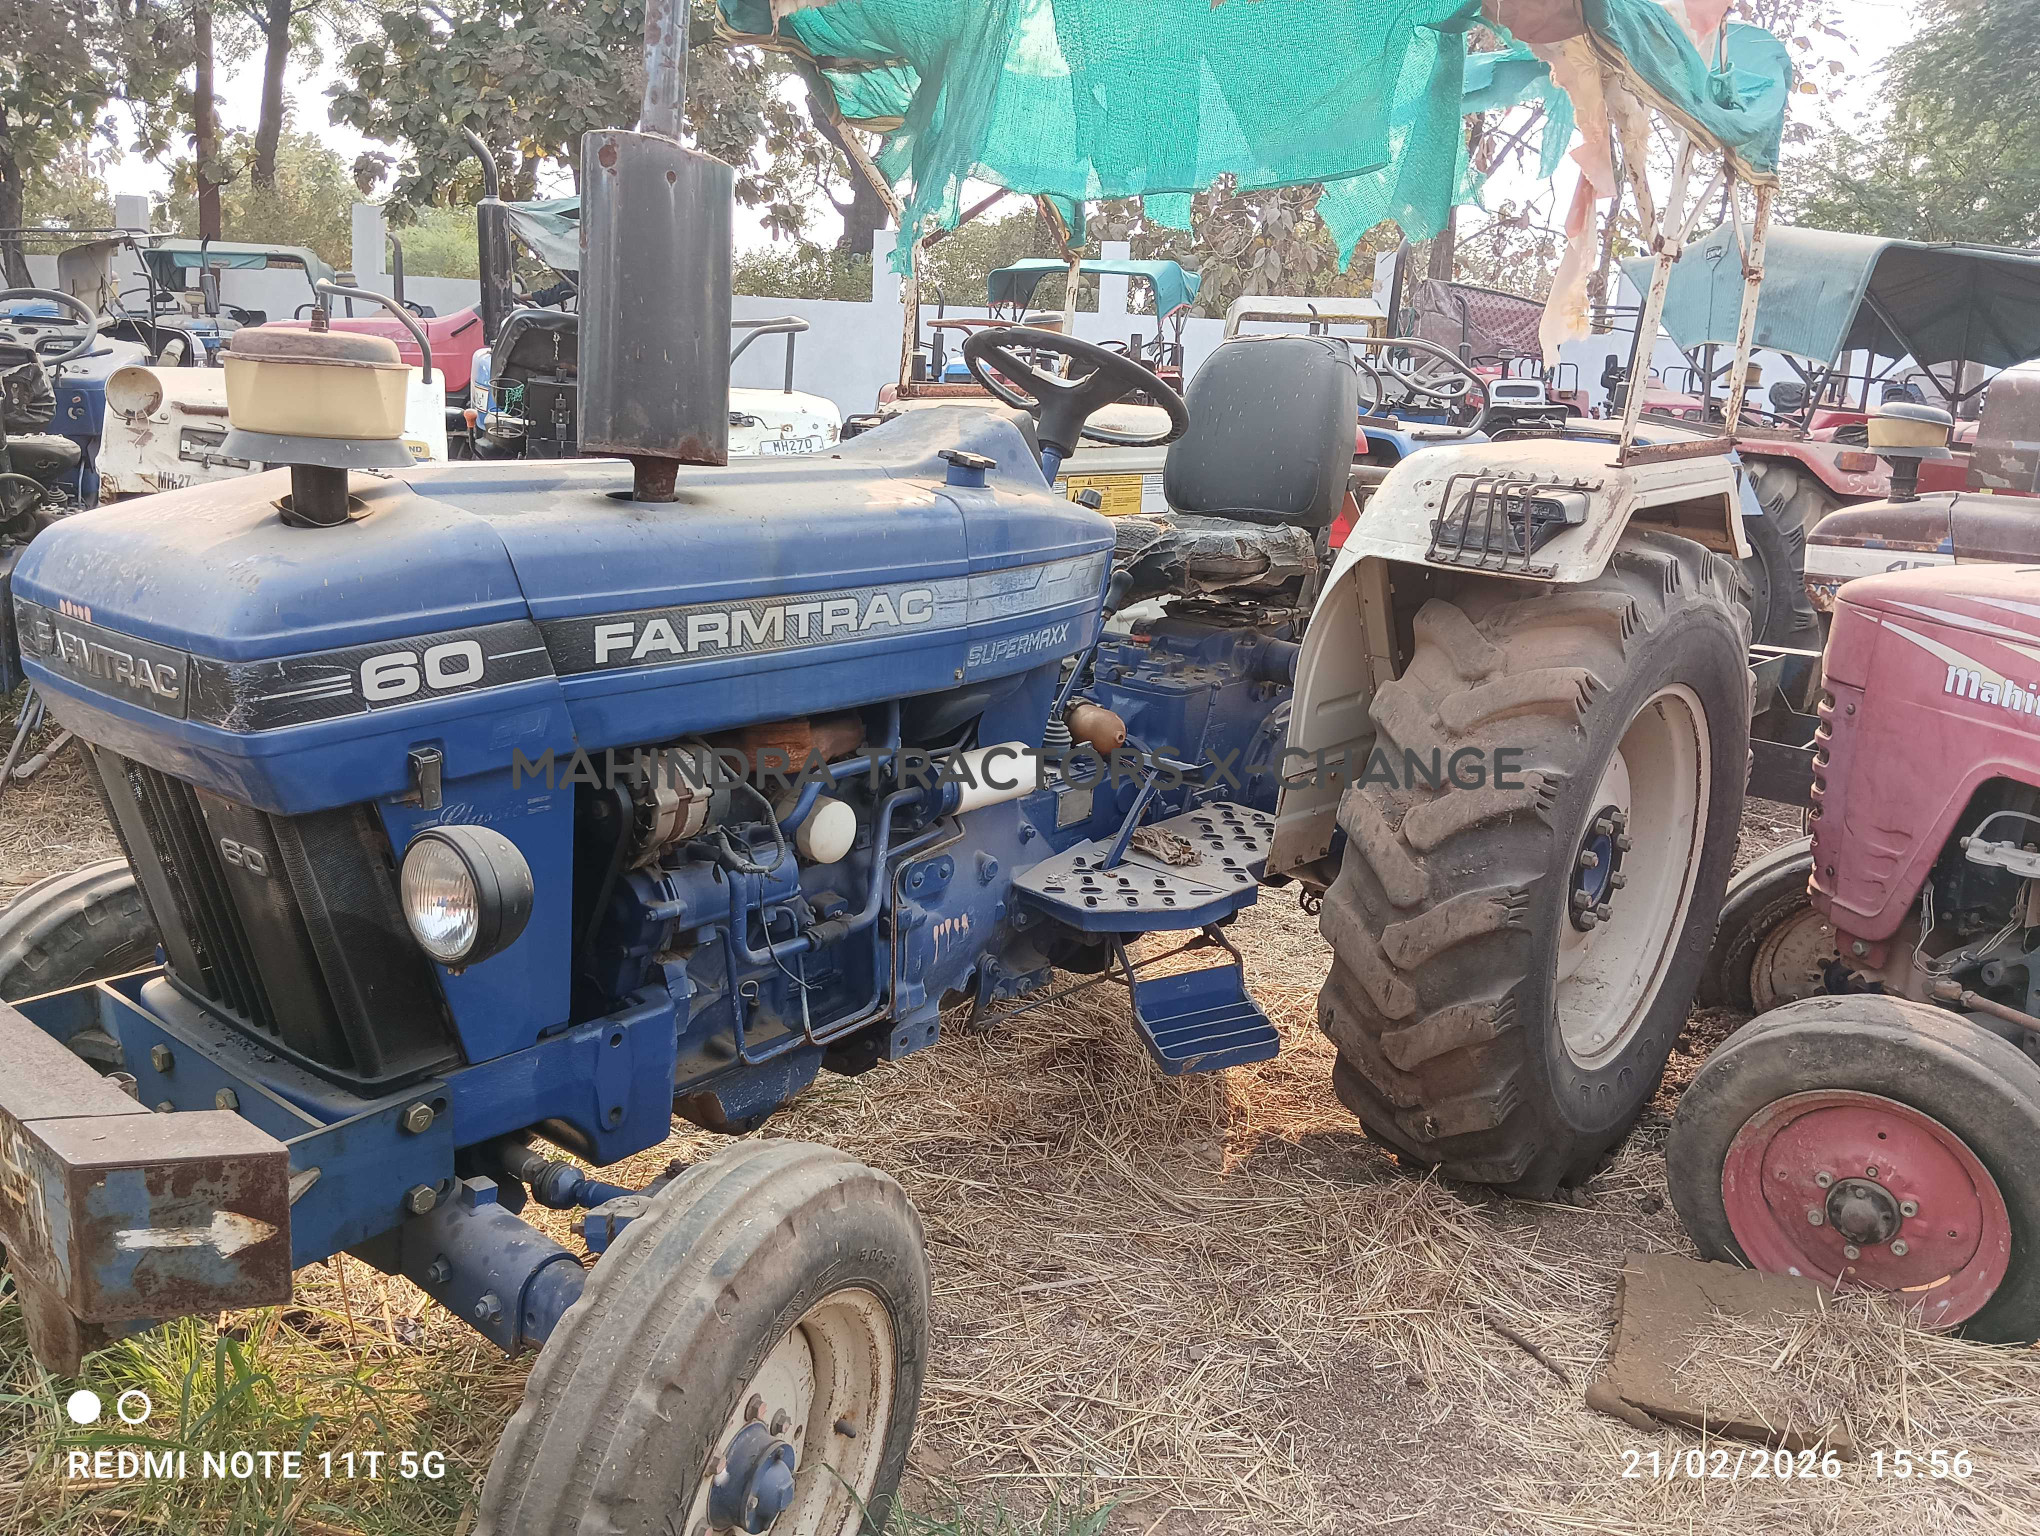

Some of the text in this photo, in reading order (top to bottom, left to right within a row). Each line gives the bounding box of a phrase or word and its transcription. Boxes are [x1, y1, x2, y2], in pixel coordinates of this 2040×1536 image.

[594, 589, 934, 664] FARMTRAC
[967, 622, 1070, 668] SUPERMAXX
[360, 640, 484, 701] 60
[220, 837, 269, 877] 60
